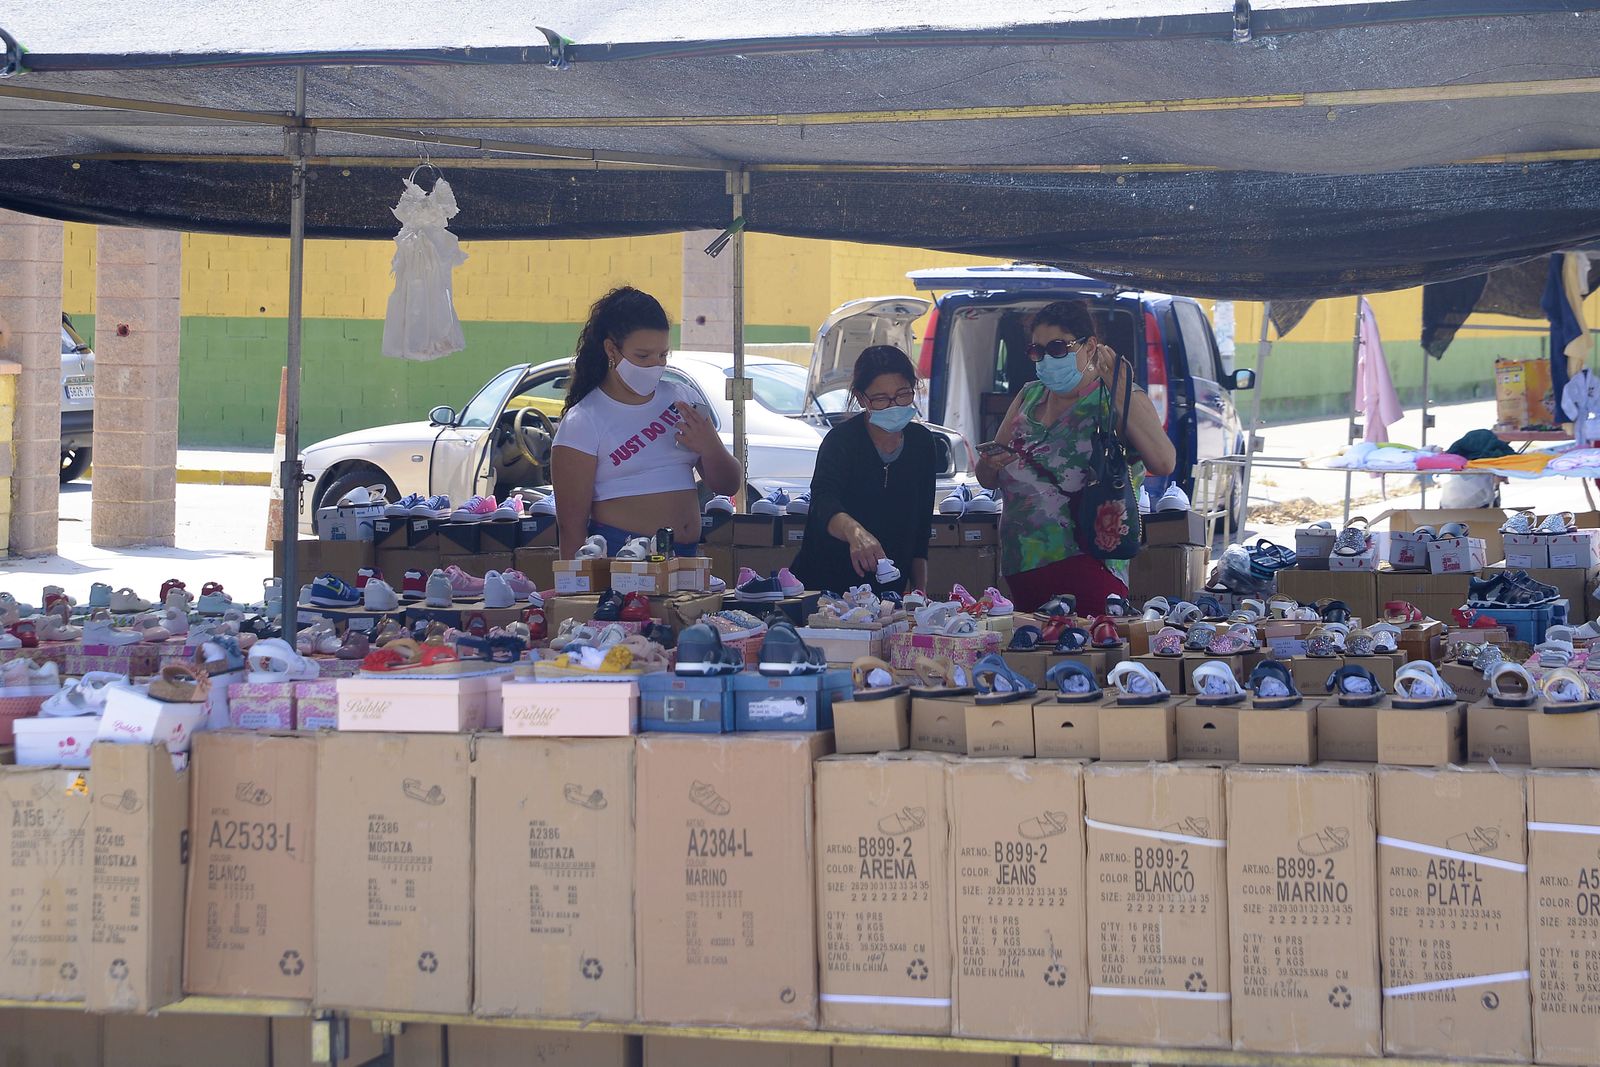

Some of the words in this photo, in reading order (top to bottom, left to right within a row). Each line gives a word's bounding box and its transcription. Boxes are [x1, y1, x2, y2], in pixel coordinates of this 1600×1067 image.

[608, 429, 647, 467] JUST
[640, 421, 667, 442] DO
[343, 698, 390, 715] Bubble
[509, 706, 557, 721] Bubble
[207, 819, 297, 852] A2533-L
[529, 827, 561, 840] A2386
[368, 840, 414, 854] MOSTAZA
[687, 827, 754, 858] A2384-L
[858, 836, 913, 858] B899-2
[529, 846, 576, 860] MOSTAZA
[994, 841, 1048, 864] B899-2
[1134, 847, 1189, 870] B899-2
[207, 863, 247, 882] BLANCO
[859, 858, 917, 880] ARENA
[1276, 856, 1335, 880] B899-2
[1426, 858, 1483, 882] A564-L
[685, 867, 728, 887] MARINO
[996, 864, 1037, 886] JEANS
[1134, 870, 1195, 893] BLANCO
[1276, 880, 1348, 904] MARINO
[1427, 882, 1483, 907] PLATA
[1002, 915, 1020, 926] PRS
[991, 927, 998, 936] 6
[1003, 926, 1021, 936] KGS
[1142, 922, 1160, 933] PRS
[1003, 936, 1021, 946] KGS
[1131, 934, 1137, 943] 6
[1142, 933, 1161, 943] KGS
[1285, 935, 1304, 945] PRS
[913, 943, 926, 953] CM
[1143, 944, 1161, 954] KGS
[1433, 939, 1451, 950] PRS
[1274, 946, 1281, 956] 6
[1286, 946, 1304, 956] KGS
[1421, 949, 1427, 959] 6
[1433, 950, 1452, 960] KGS
[827, 961, 851, 971] MADE
[852, 962, 860, 971] IN
[862, 961, 888, 972] CHINA
[1191, 956, 1205, 967] CM
[1286, 957, 1305, 967] KGS
[1434, 961, 1453, 971] KGS
[1573, 960, 1579, 969] 6
[963, 967, 987, 977] MADE
[988, 967, 997, 977] IN
[999, 967, 1026, 978] CHINA
[1335, 968, 1349, 980] CM
[1101, 974, 1126, 984] MADE
[1127, 975, 1137, 985] IN
[1138, 975, 1166, 986] CHINA
[1244, 987, 1268, 997] MADE
[1270, 987, 1279, 998] IN
[1280, 987, 1309, 999] CHINA
[1428, 992, 1457, 1003] CHINA
[1541, 1002, 1567, 1013] MADE
[1569, 1003, 1578, 1013] IN
